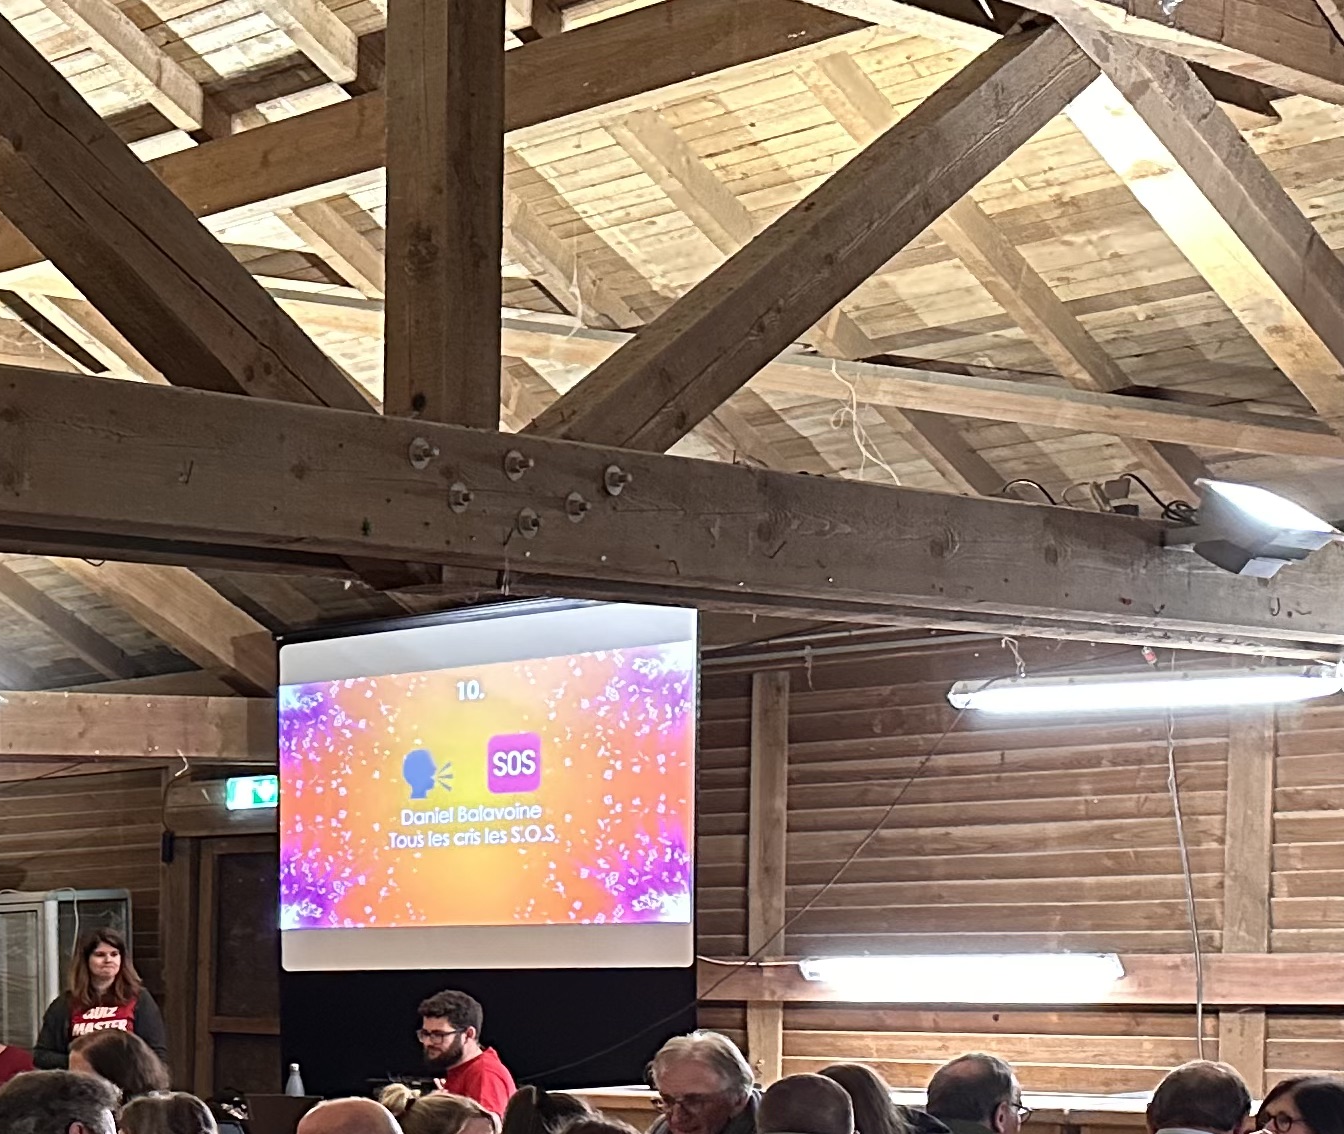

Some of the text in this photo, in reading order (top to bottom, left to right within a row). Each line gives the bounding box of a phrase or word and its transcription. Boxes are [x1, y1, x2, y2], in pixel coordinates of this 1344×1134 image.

[456, 680, 485, 701] 10.
[492, 749, 536, 777] SOS
[400, 803, 542, 826] Daniel Balavoine
[388, 824, 560, 849] Tous les cris les S.O.S.
[72, 1019, 128, 1037] MASTER
